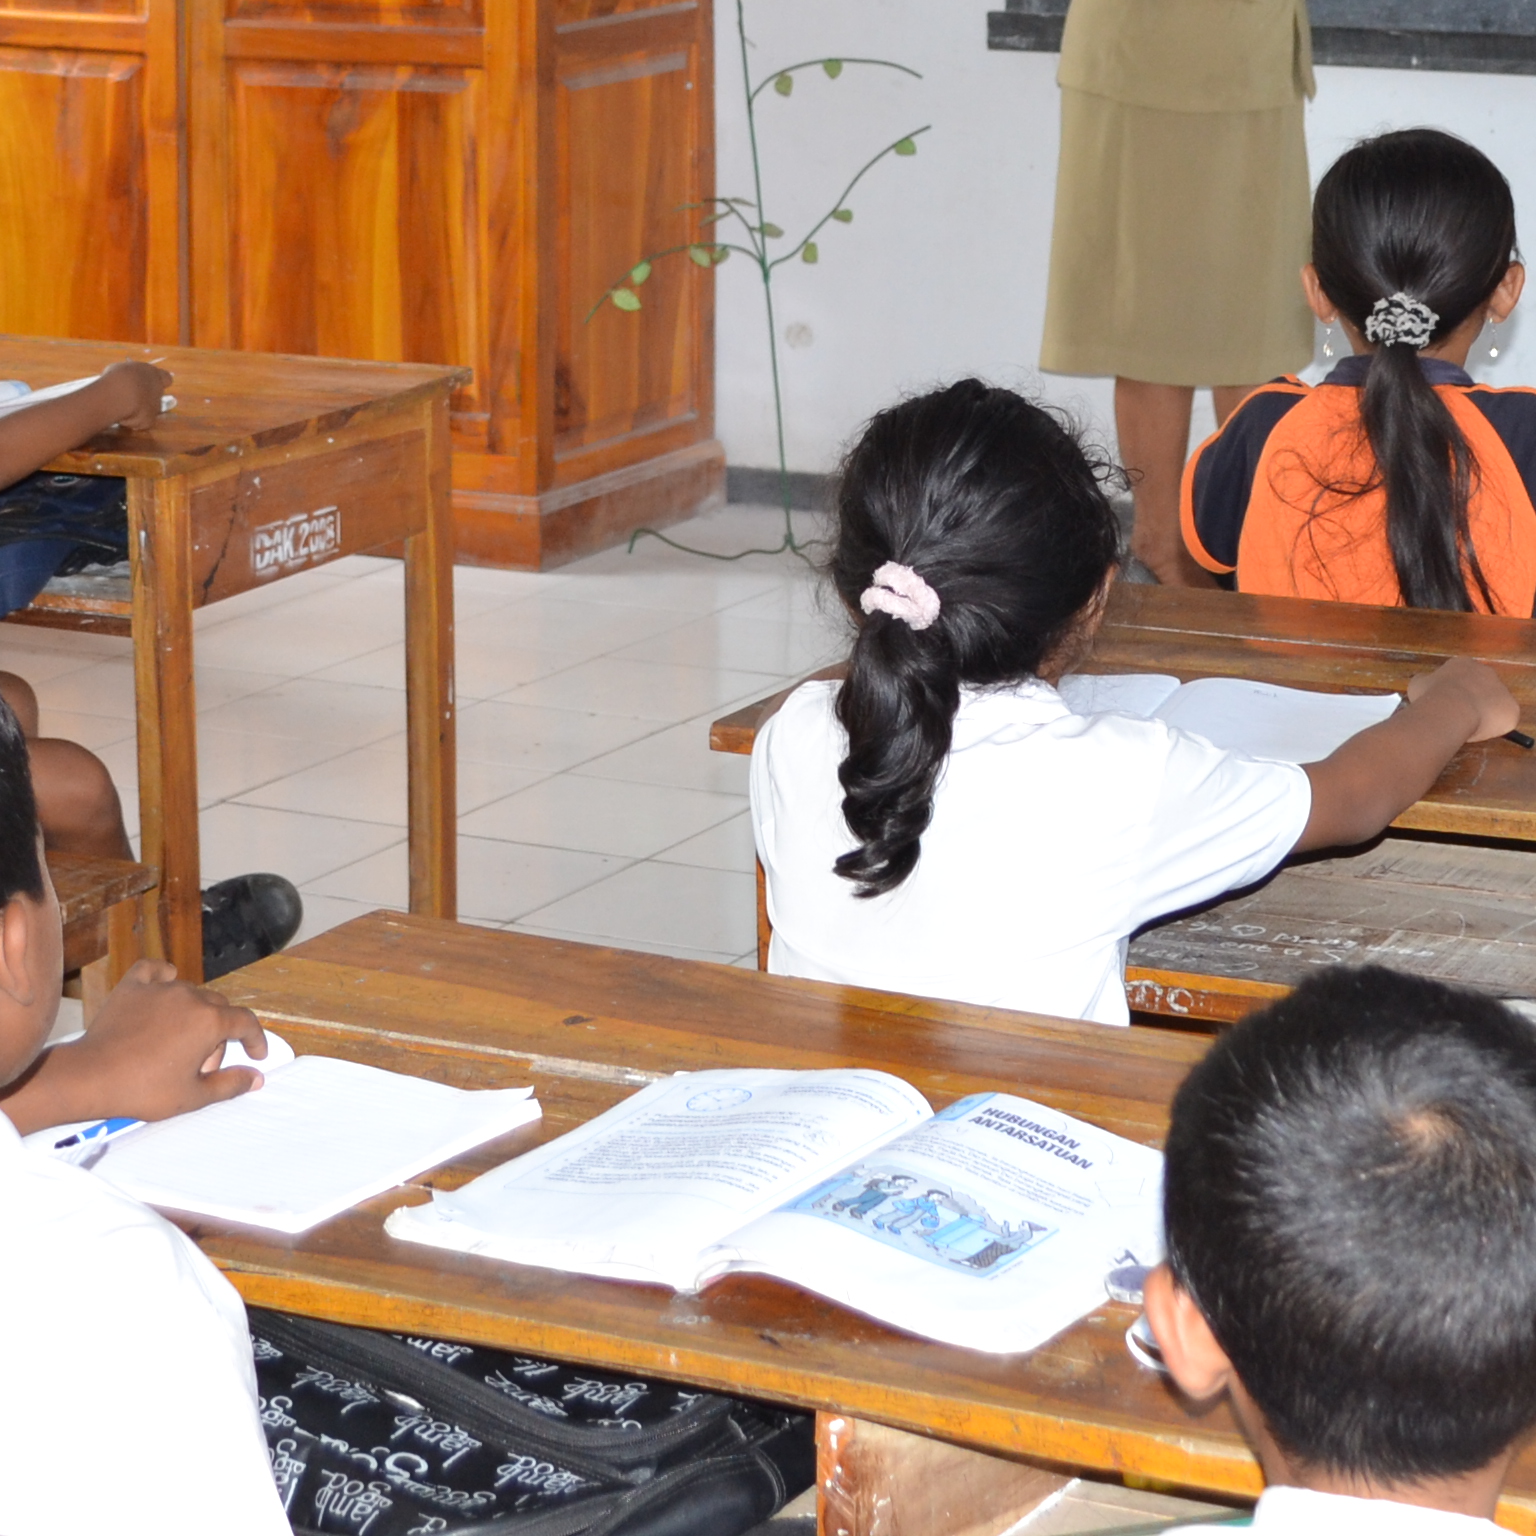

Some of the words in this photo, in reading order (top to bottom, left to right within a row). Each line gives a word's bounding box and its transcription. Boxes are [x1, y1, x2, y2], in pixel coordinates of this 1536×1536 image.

[968, 1116, 1094, 1170] ANTARSATUAN
[981, 1107, 1081, 1149] HUBUNGAN
[315, 1487, 379, 1536] lamb
